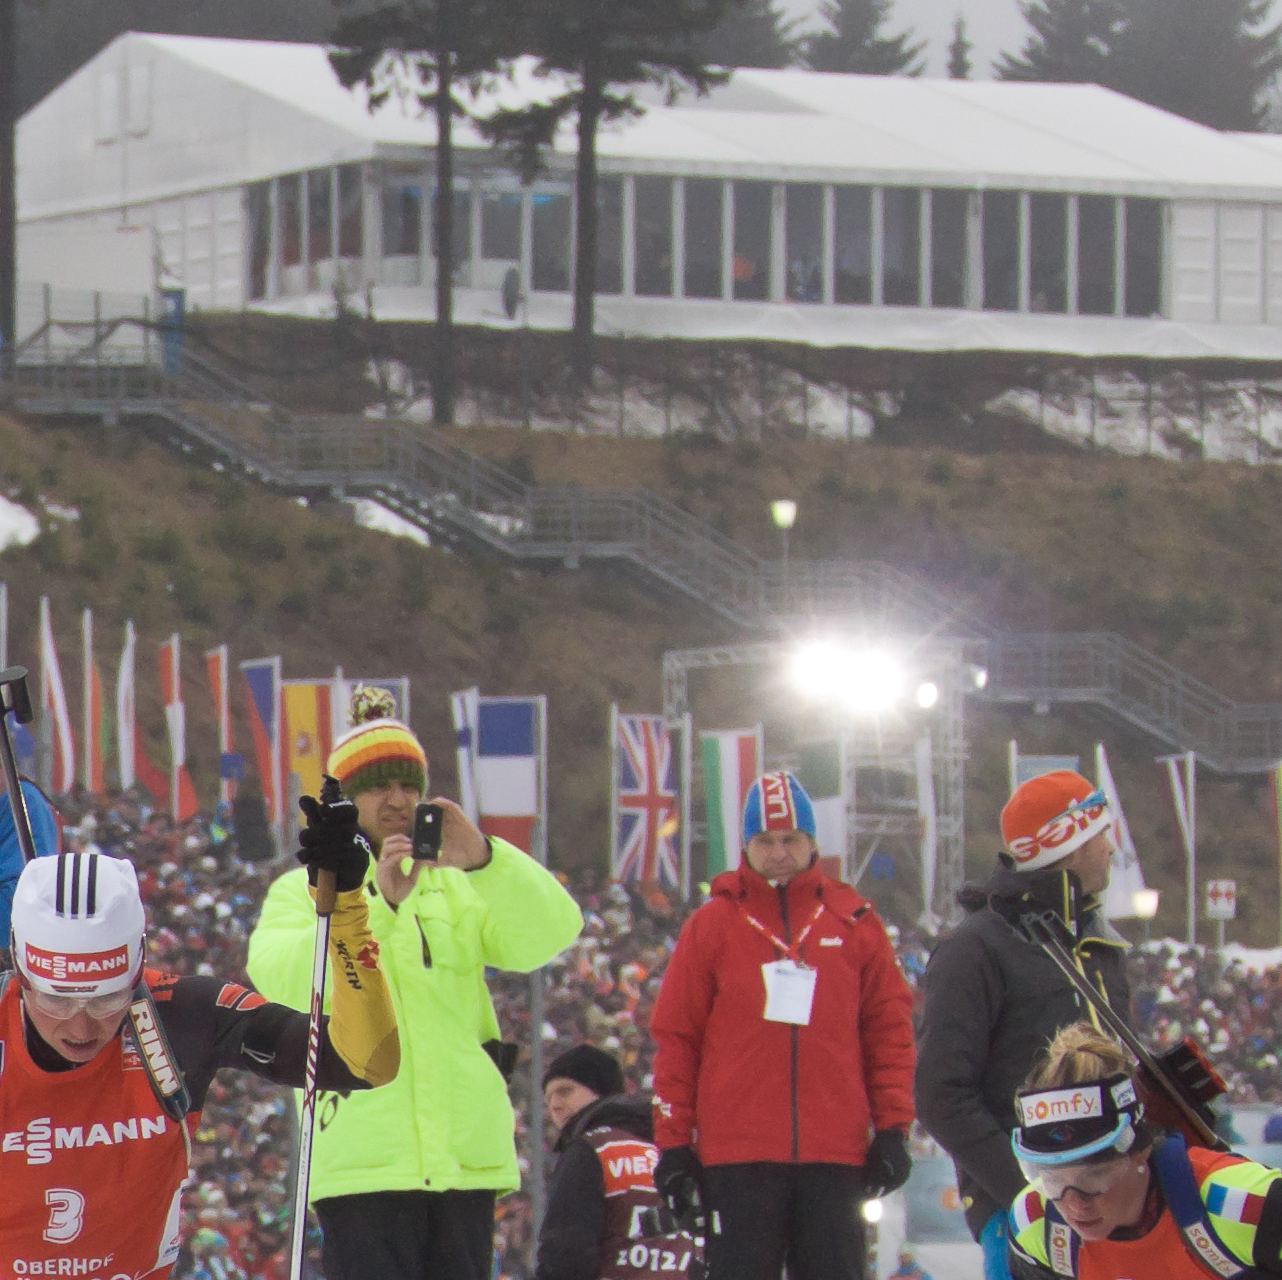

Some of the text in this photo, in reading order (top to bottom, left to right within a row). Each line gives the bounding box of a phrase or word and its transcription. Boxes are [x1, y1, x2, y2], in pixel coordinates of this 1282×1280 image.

[26, 950, 126, 979] VIESSMANN
[1026, 1092, 1097, 1121] somfy
[43, 1188, 85, 1244] 3
[13, 1252, 115, 1276] OBERHOF
